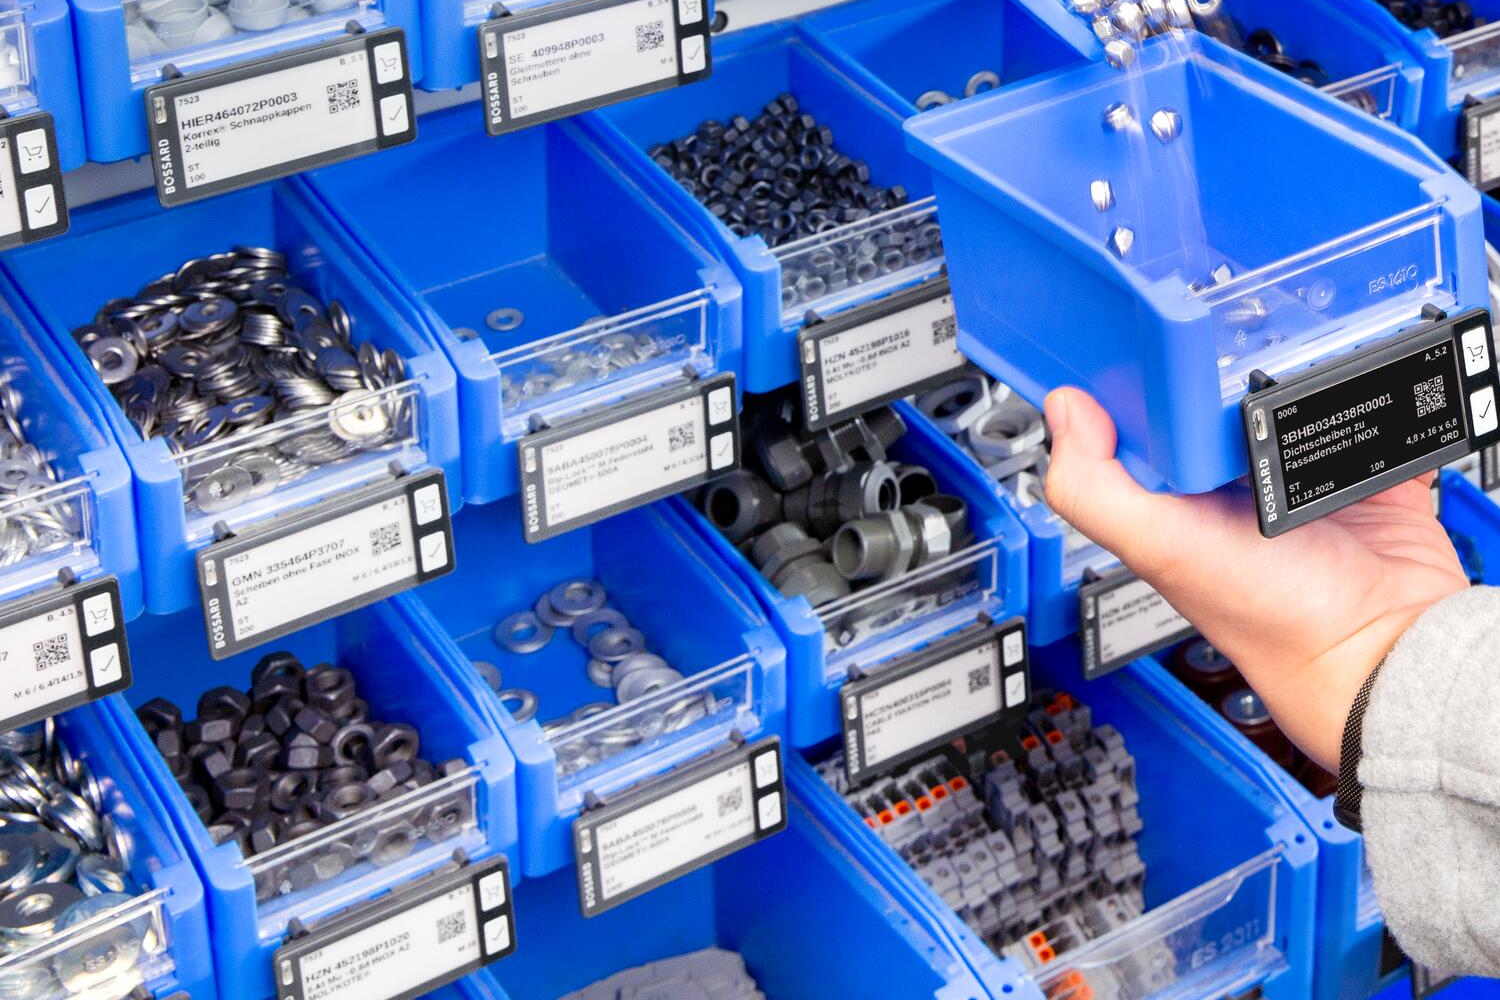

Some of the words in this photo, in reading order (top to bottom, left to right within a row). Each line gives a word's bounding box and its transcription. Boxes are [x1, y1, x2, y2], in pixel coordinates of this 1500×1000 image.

[508, 52, 524, 65] SE
[531, 32, 605, 59] 409948P0003
[509, 55, 566, 76] Gleitmuttern
[568, 48, 591, 61] ohne
[511, 66, 560, 86] Schrauben
[178, 94, 199, 106] 7523
[180, 92, 297, 130] HIER464072P0003
[488, 72, 502, 124] BOSSARD
[229, 102, 312, 132] Schnappkappen
[184, 136, 220, 154] 2-teilig
[159, 139, 176, 195] BOSSARD
[187, 162, 200, 172] ST
[189, 172, 206, 183] 100
[824, 351, 845, 366] HZN
[1424, 345, 1447, 363] A_5.2
[807, 375, 819, 422] BOSSARD
[1277, 405, 1297, 420] 0006
[1280, 391, 1393, 447] 3BHB034338R0001
[1283, 424, 1351, 460] Dichtscheiben
[1353, 420, 1365, 431] zu
[1405, 433, 1418, 446] 4,8
[1419, 431, 1425, 439] x
[1427, 425, 1437, 436] 16
[1438, 424, 1443, 432] x
[1444, 417, 1457, 430] 6,8
[1439, 428, 1459, 444] ORD
[1285, 436, 1352, 472] Fassadenschr
[1354, 425, 1379, 444] INOX
[1369, 459, 1385, 473] 100
[1259, 458, 1277, 523] BOSSARD
[1288, 481, 1300, 493] ST
[1290, 480, 1334, 506] 11.12.2025
[527, 484, 539, 533] BOSSARD
[228, 552, 249, 566] 7523
[231, 568, 262, 587] GMN
[265, 538, 345, 574] 335464P3707
[233, 575, 279, 598] Scheiben
[282, 565, 306, 581] ohne
[309, 556, 332, 571] Fase
[334, 546, 359, 561] INOX
[235, 597, 248, 608] A2
[210, 598, 226, 649] BOSSARD
[237, 615, 248, 625] ST
[583, 862, 596, 909] BOSSARD
[371, 948, 396, 965] INOX
[305, 964, 332, 984] HZN
